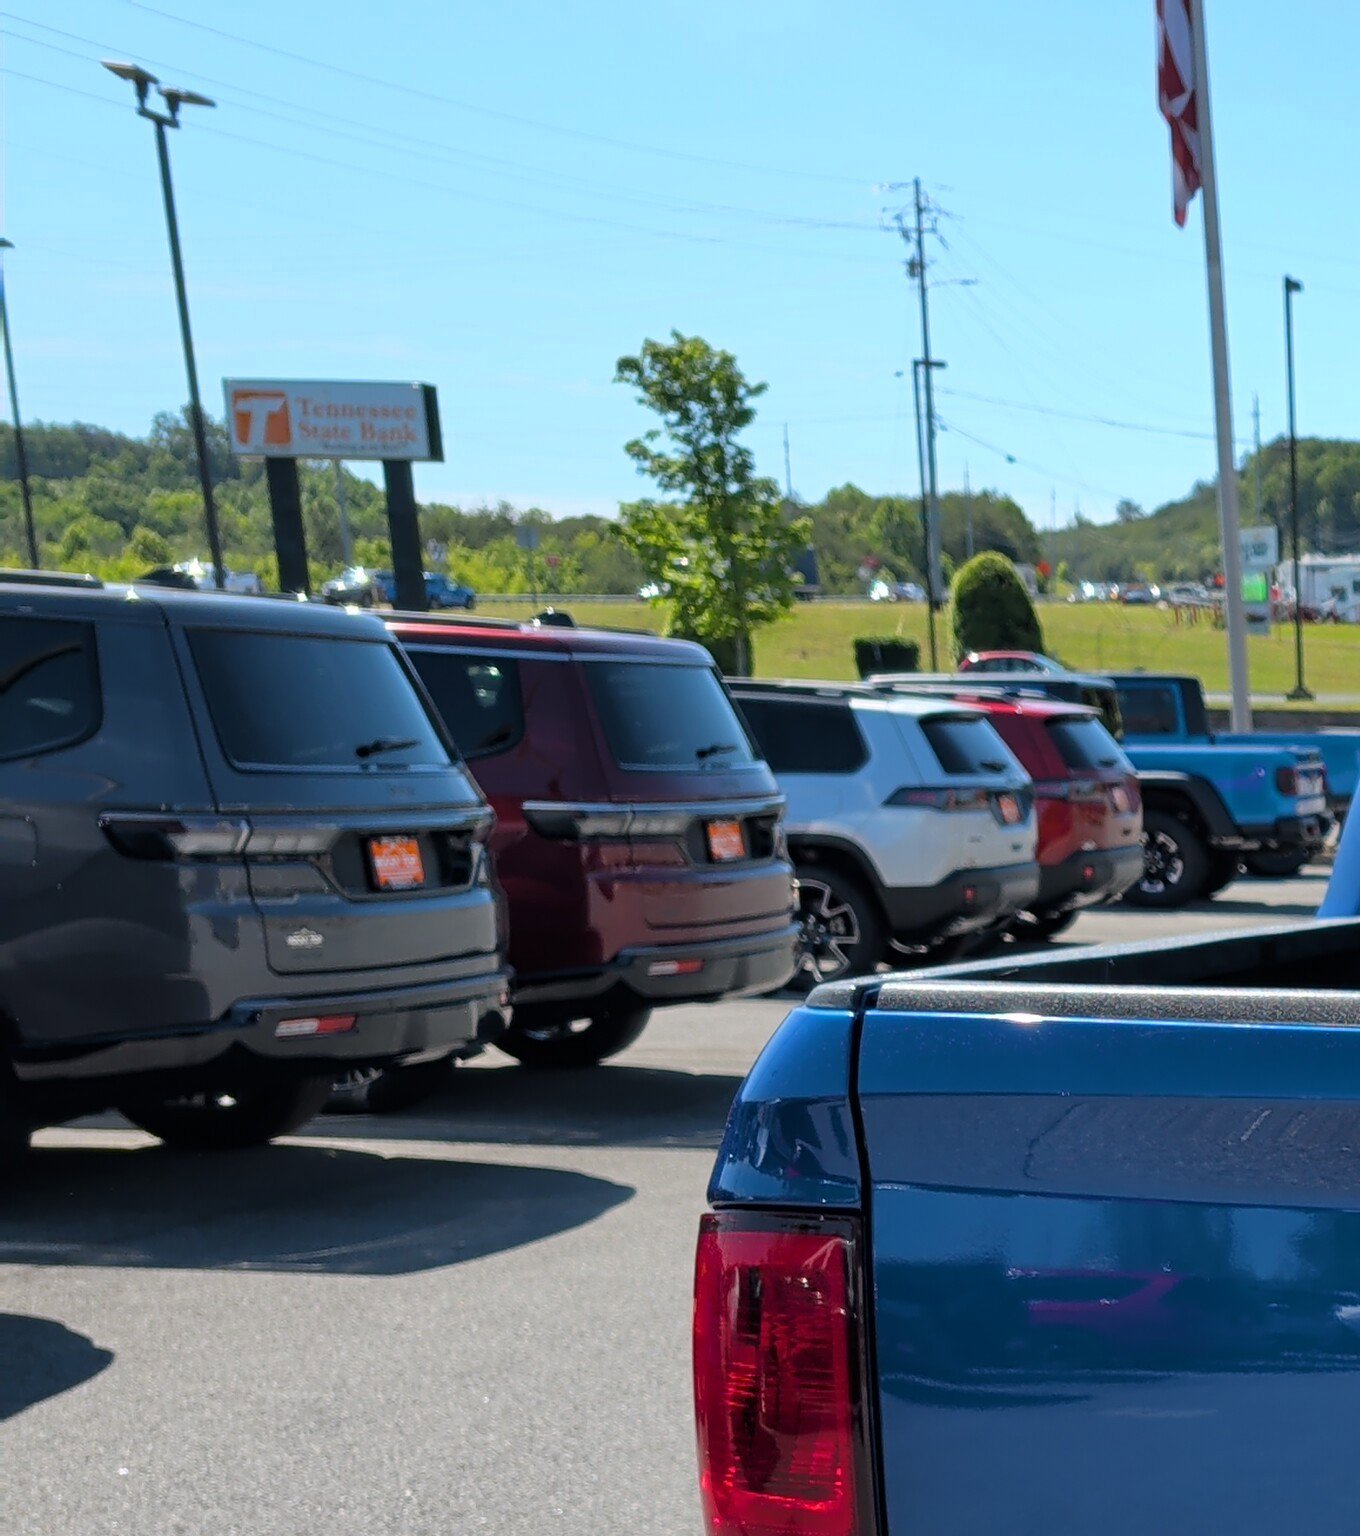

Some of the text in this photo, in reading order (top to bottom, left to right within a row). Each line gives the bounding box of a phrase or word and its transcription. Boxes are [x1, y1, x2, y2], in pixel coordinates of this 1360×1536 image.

[294, 396, 417, 419] Tennessee
[298, 422, 417, 442] State Bank
